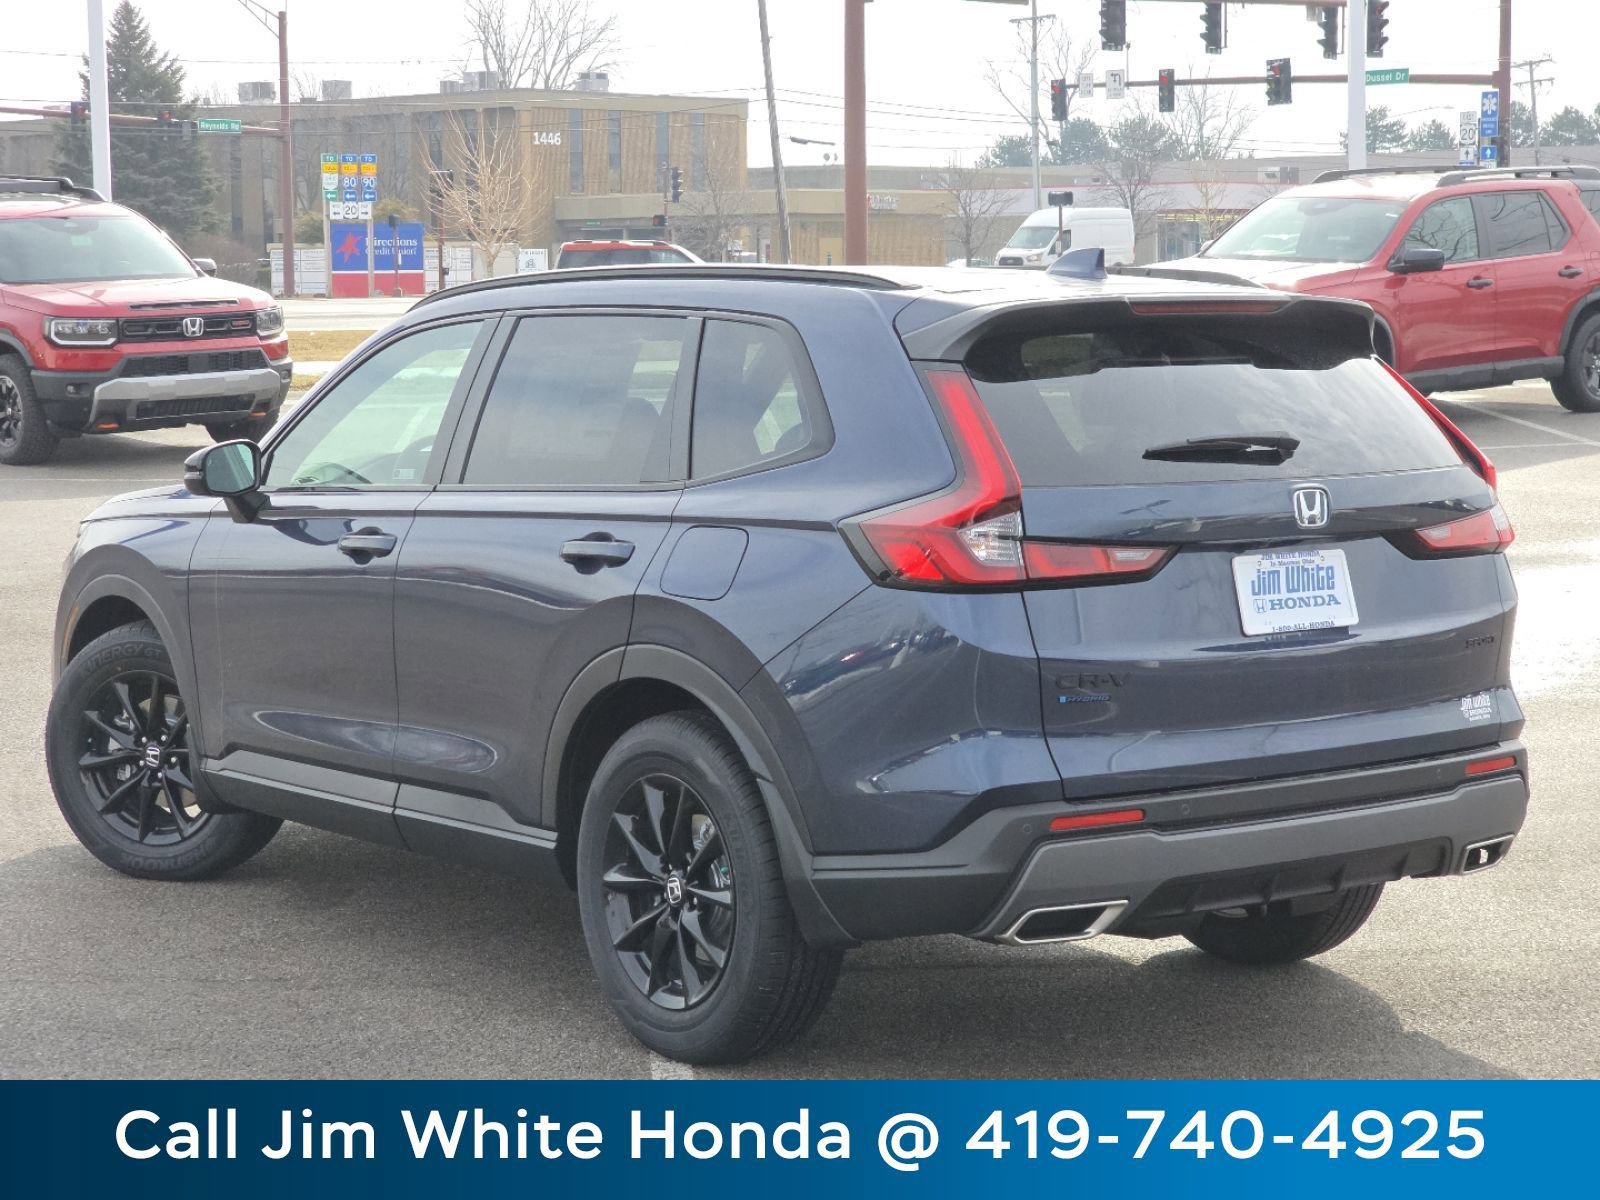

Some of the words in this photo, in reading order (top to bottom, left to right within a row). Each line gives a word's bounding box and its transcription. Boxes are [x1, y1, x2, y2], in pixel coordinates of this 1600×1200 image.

[1366, 72, 1392, 82] Dussel
[1395, 71, 1405, 81] Dr
[230, 122, 240, 130] Rd
[533, 131, 562, 146] 1446
[1460, 128, 1476, 141] 20
[343, 177, 357, 188] 80
[362, 177, 375, 188] 90
[345, 204, 358, 216] 20
[1251, 568, 1281, 596] Jim
[1285, 564, 1335, 593] White
[1268, 594, 1342, 611] HONDA
[1056, 671, 1130, 690] CR-V
